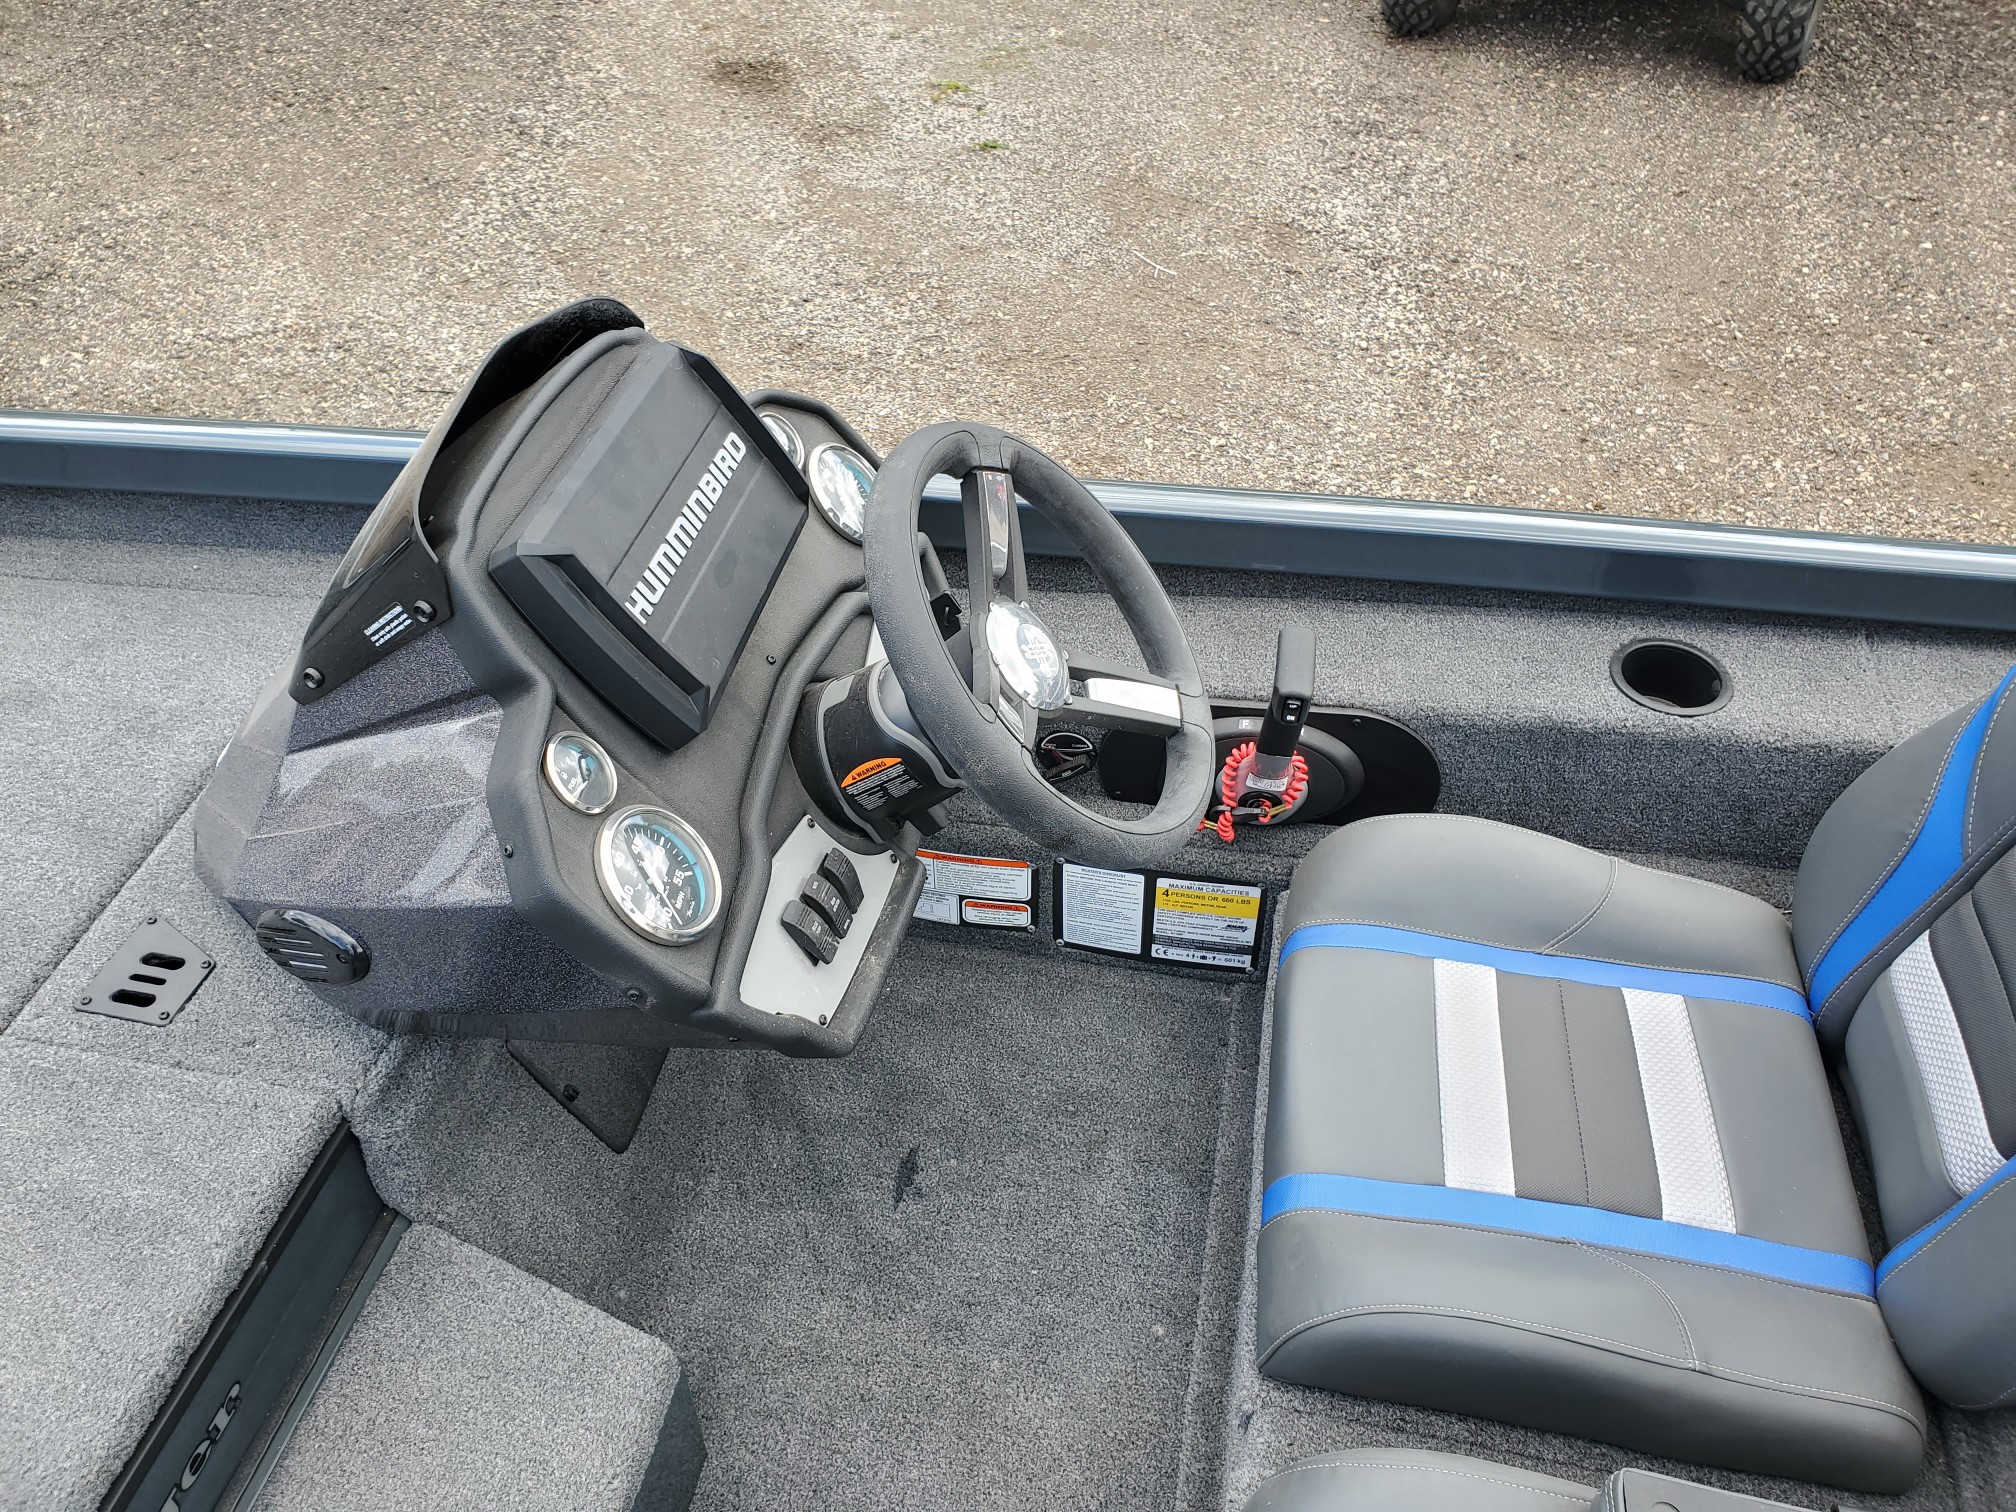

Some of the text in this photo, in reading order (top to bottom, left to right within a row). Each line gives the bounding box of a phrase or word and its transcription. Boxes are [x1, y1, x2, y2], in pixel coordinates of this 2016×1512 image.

[624, 431, 747, 625] HUMMINBIRD
[1242, 719, 1250, 729] F
[856, 761, 887, 778] WARNING
[568, 777, 578, 791] FUEL
[941, 855, 975, 864] WARNING
[672, 869, 686, 887] 55
[1103, 871, 1126, 879] CHECKLIST
[1162, 889, 1169, 898] 4
[1170, 891, 1206, 901] PERSONS
[1168, 883, 1250, 896] MAXIMUM CAPACITIES
[675, 890, 686, 910] MPH
